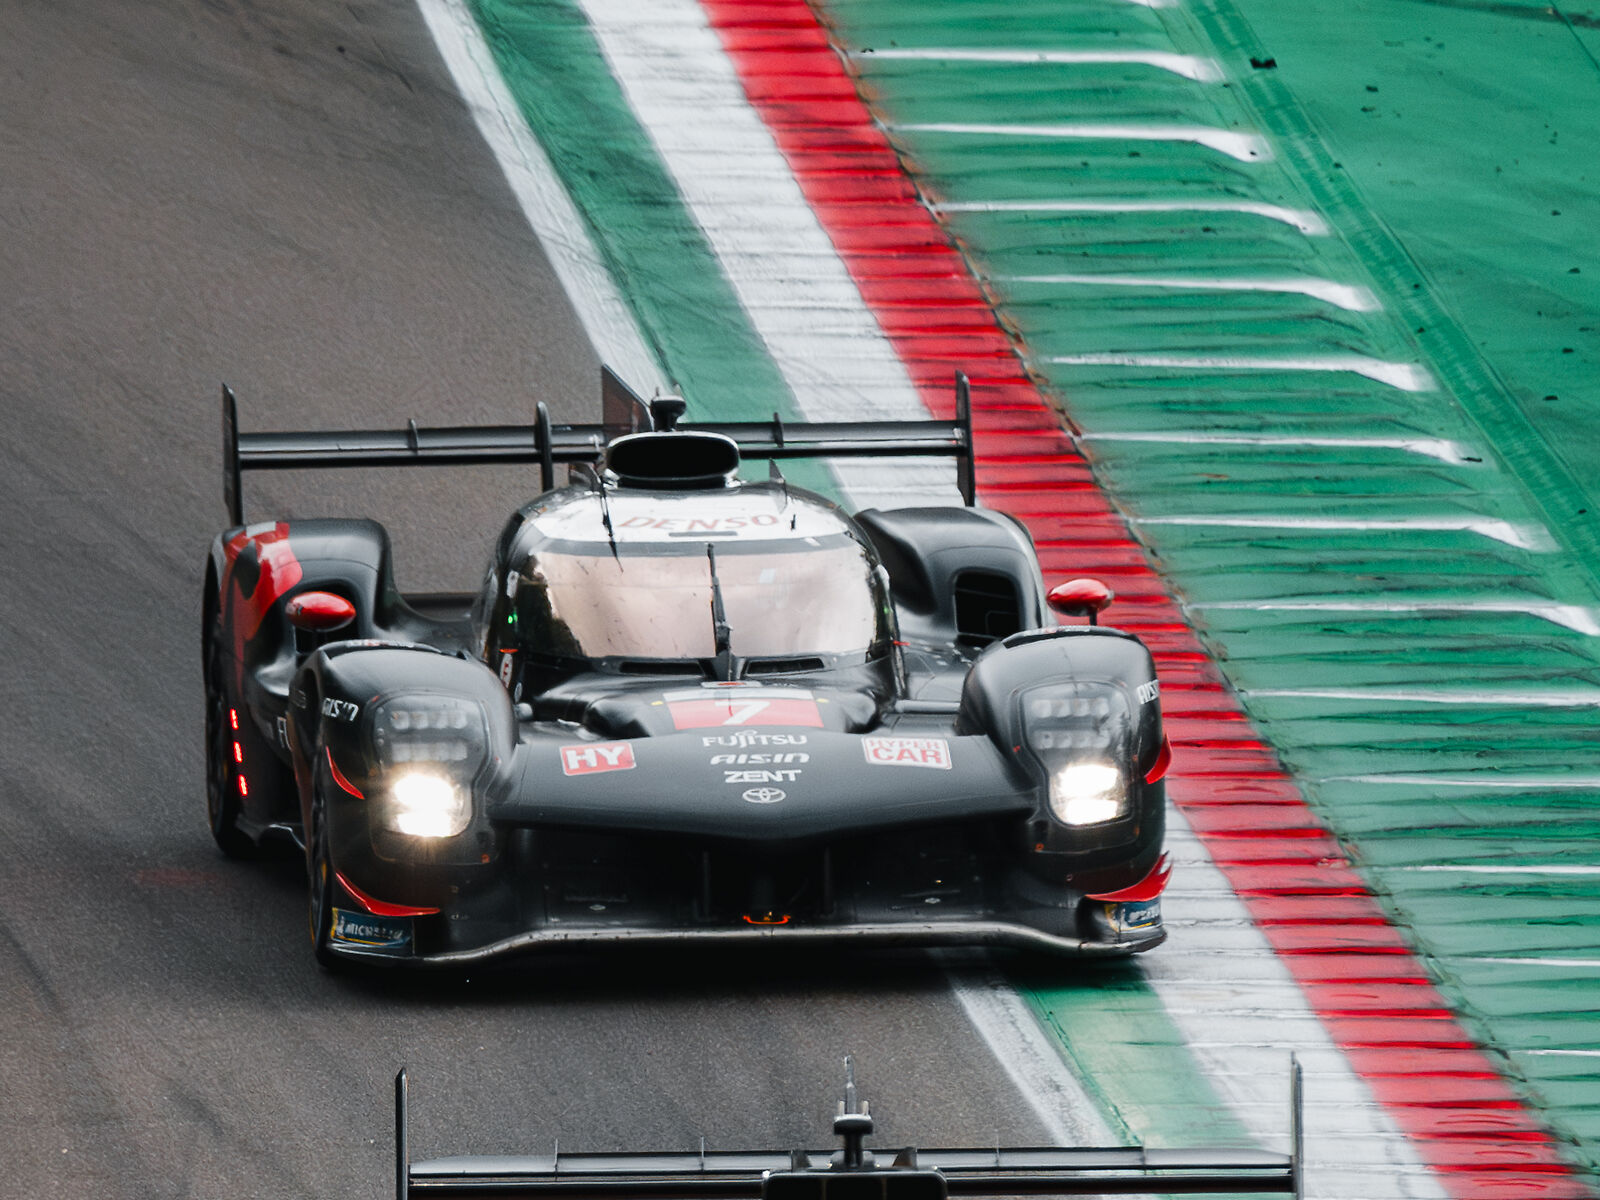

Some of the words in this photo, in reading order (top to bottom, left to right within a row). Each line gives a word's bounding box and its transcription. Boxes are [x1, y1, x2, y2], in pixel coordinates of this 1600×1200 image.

[618, 514, 779, 530] DENSO
[714, 700, 771, 725] 7
[702, 731, 808, 748] FUJITSU
[565, 745, 625, 770] HY
[710, 752, 810, 765] AISIN
[871, 746, 943, 764] CAR
[723, 769, 802, 783] ZENT
